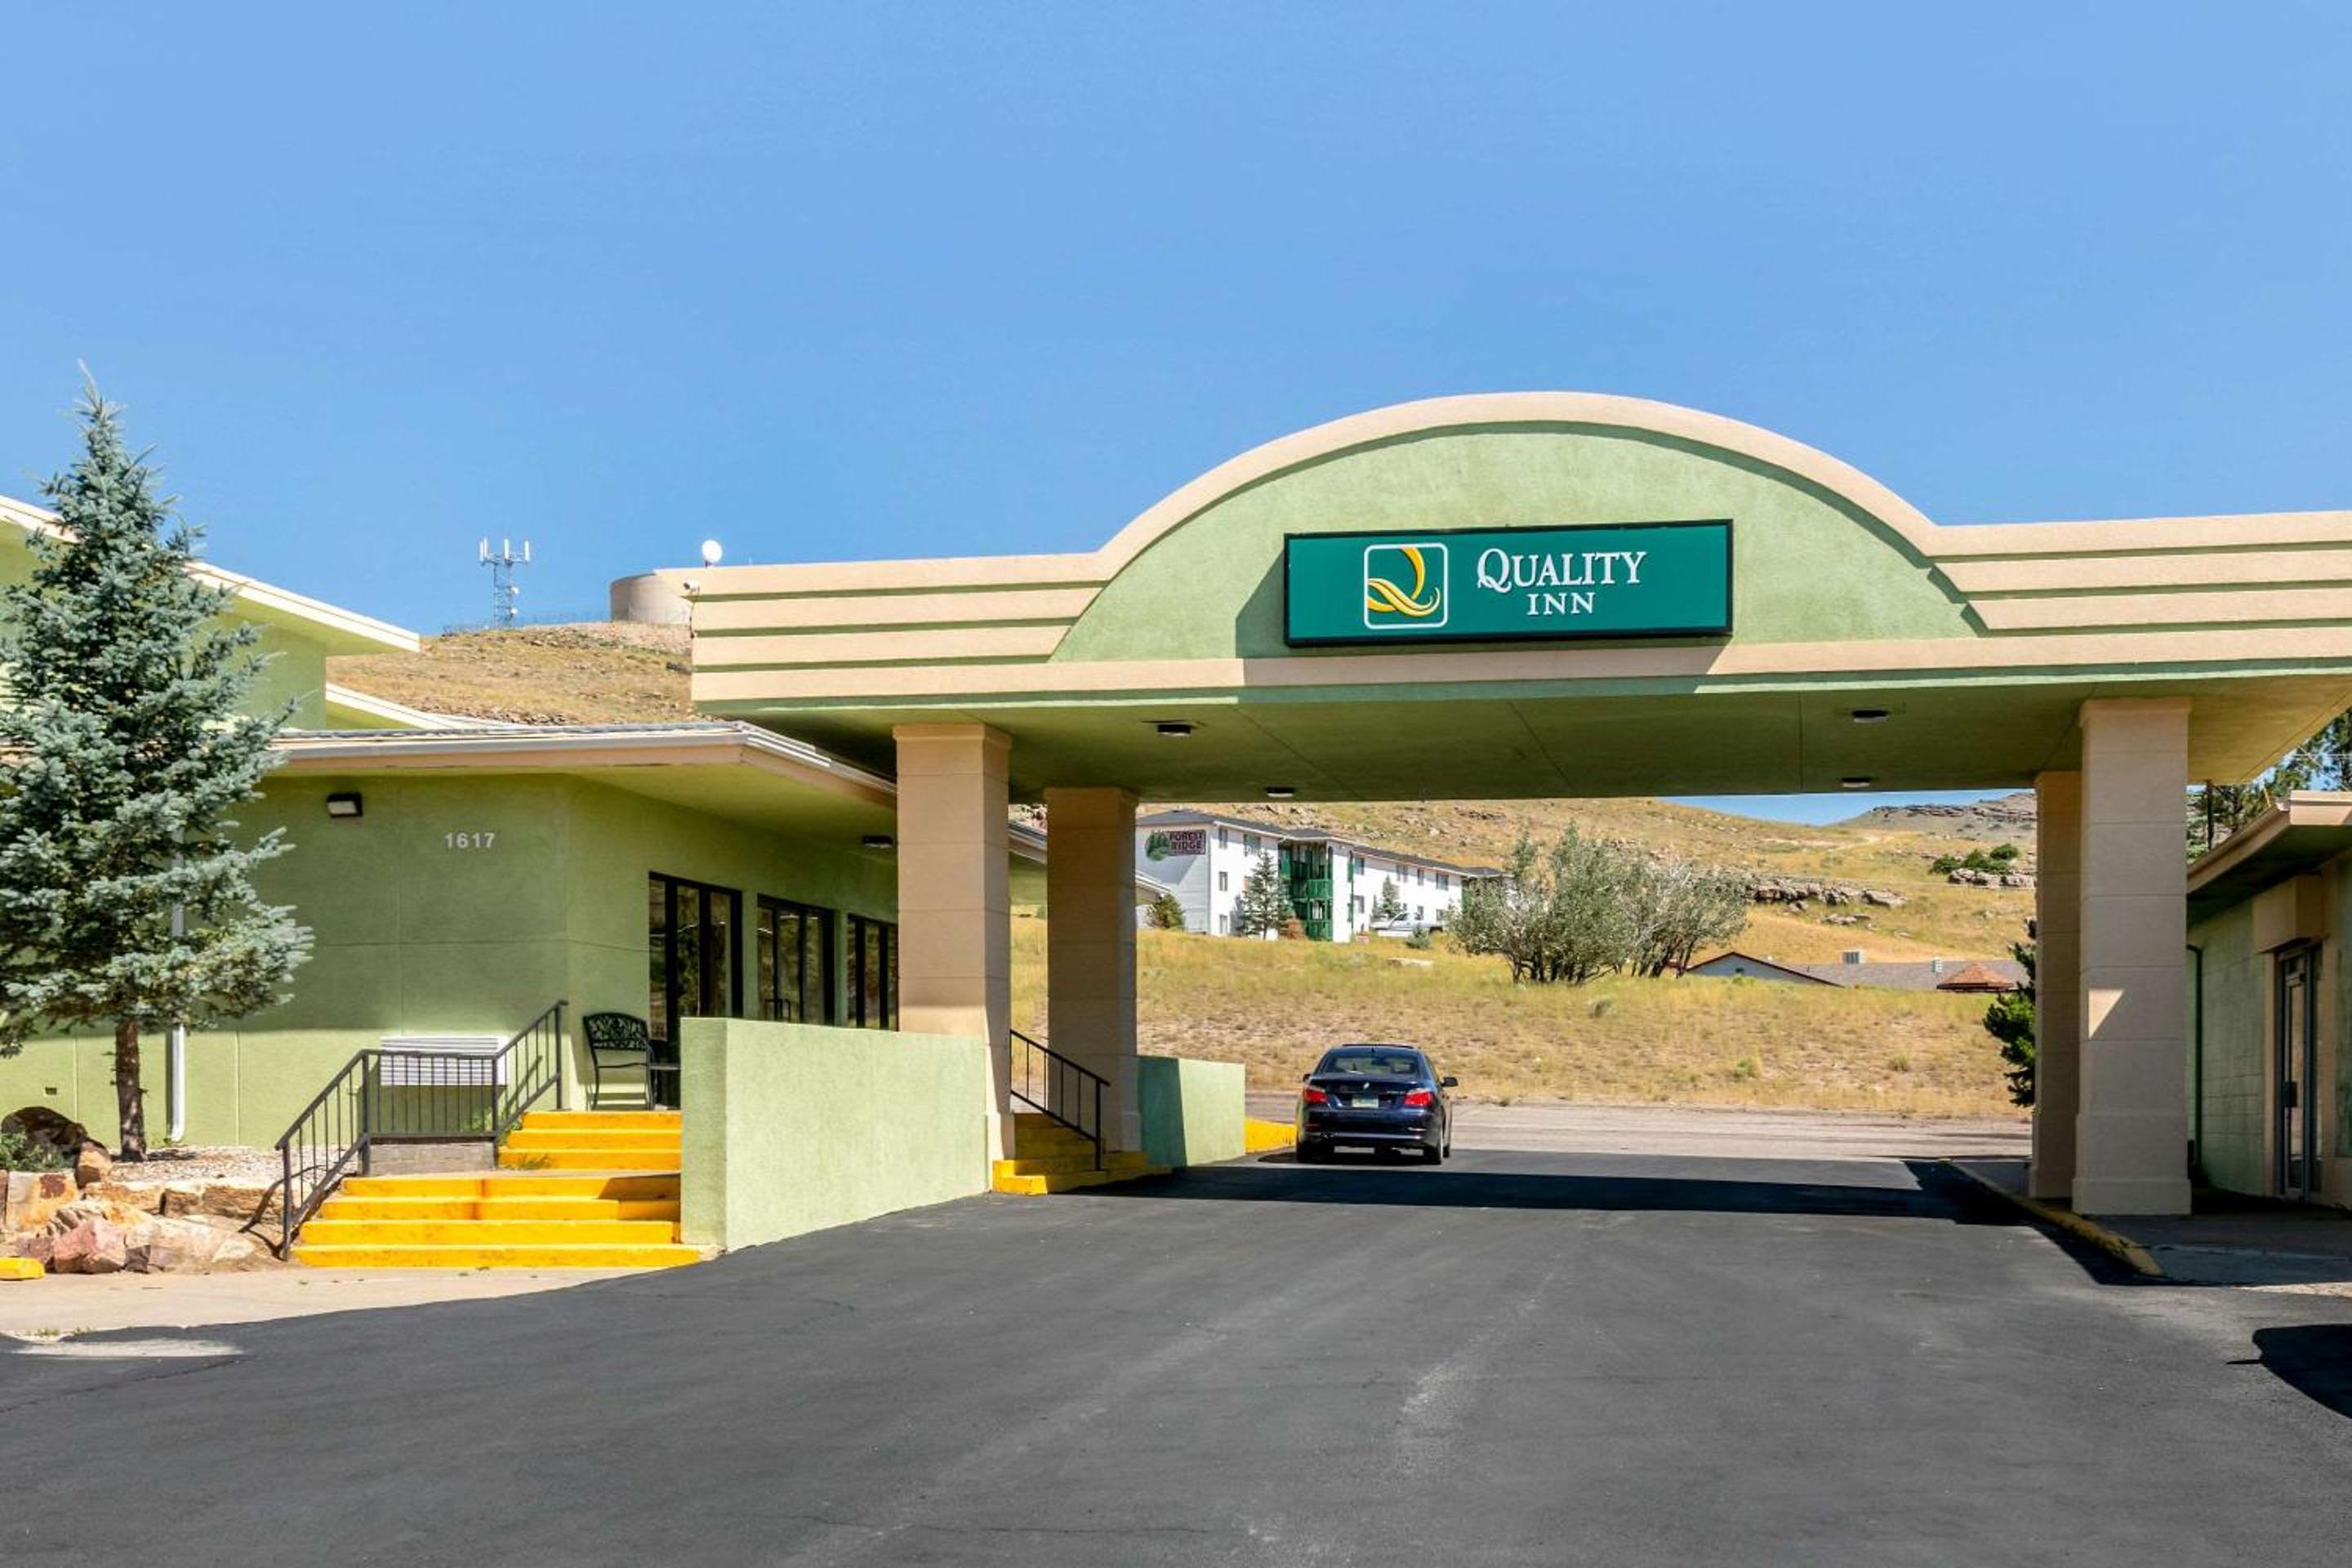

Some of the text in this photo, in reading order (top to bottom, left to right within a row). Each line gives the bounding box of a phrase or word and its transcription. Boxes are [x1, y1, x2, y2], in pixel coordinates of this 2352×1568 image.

[1477, 548, 1647, 594] QUALITY
[1526, 591, 1596, 616] INN
[444, 832, 495, 849] 1617
